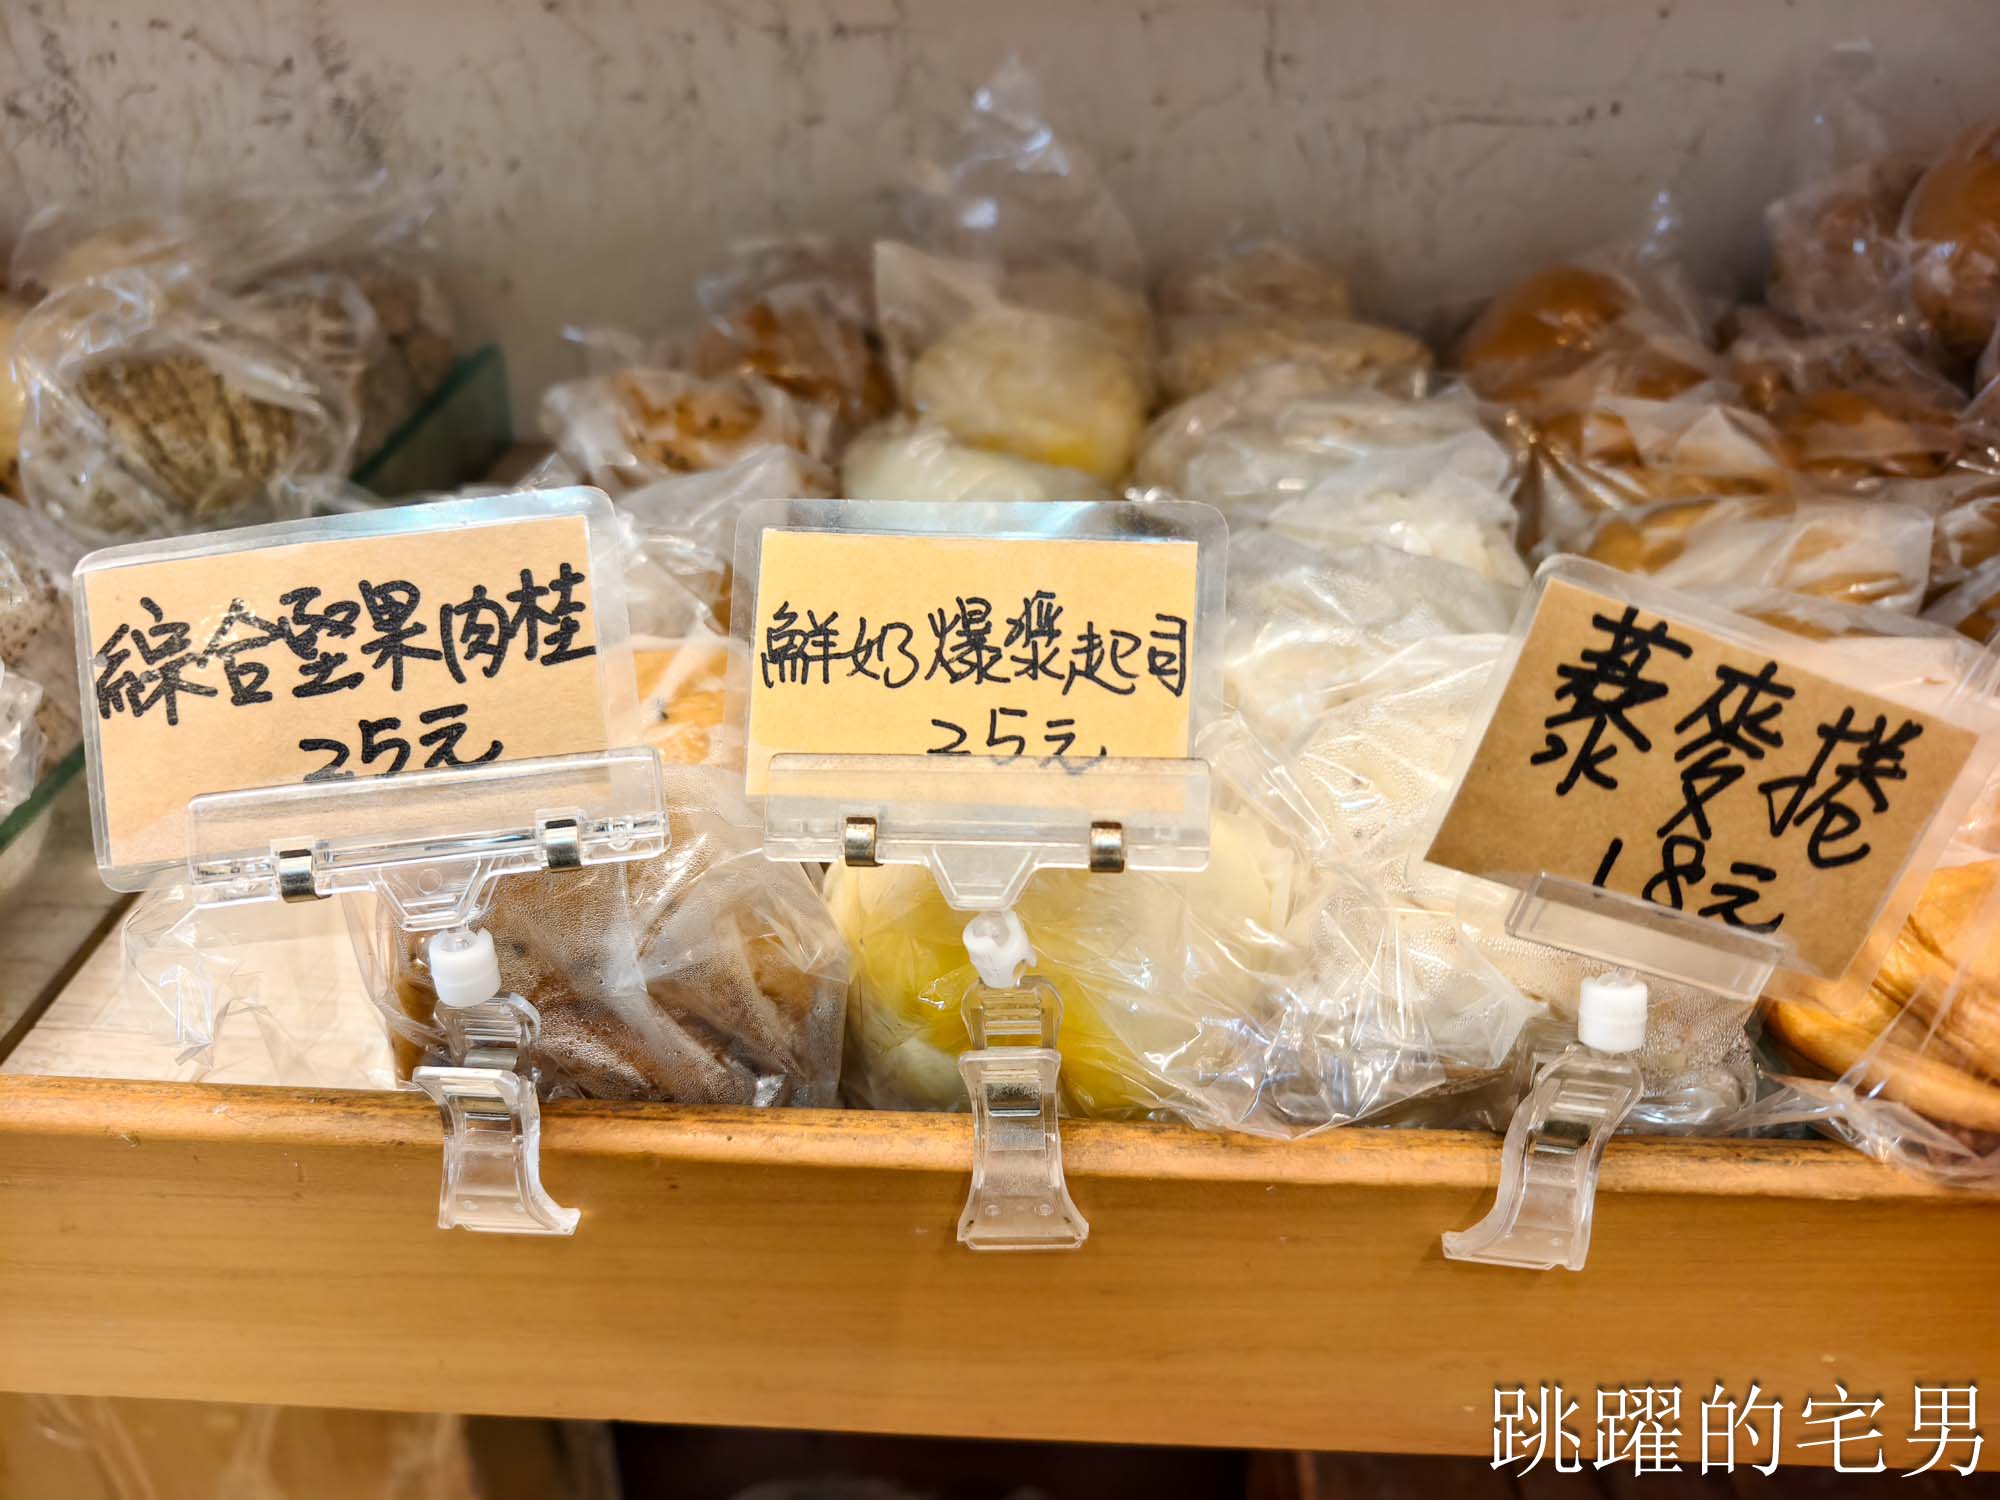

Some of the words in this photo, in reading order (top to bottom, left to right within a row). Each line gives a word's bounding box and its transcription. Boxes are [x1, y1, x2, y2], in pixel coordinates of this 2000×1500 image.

[298, 703, 504, 784] 25元
[926, 707, 1107, 776] 25元
[1592, 835, 1785, 932] 18元
